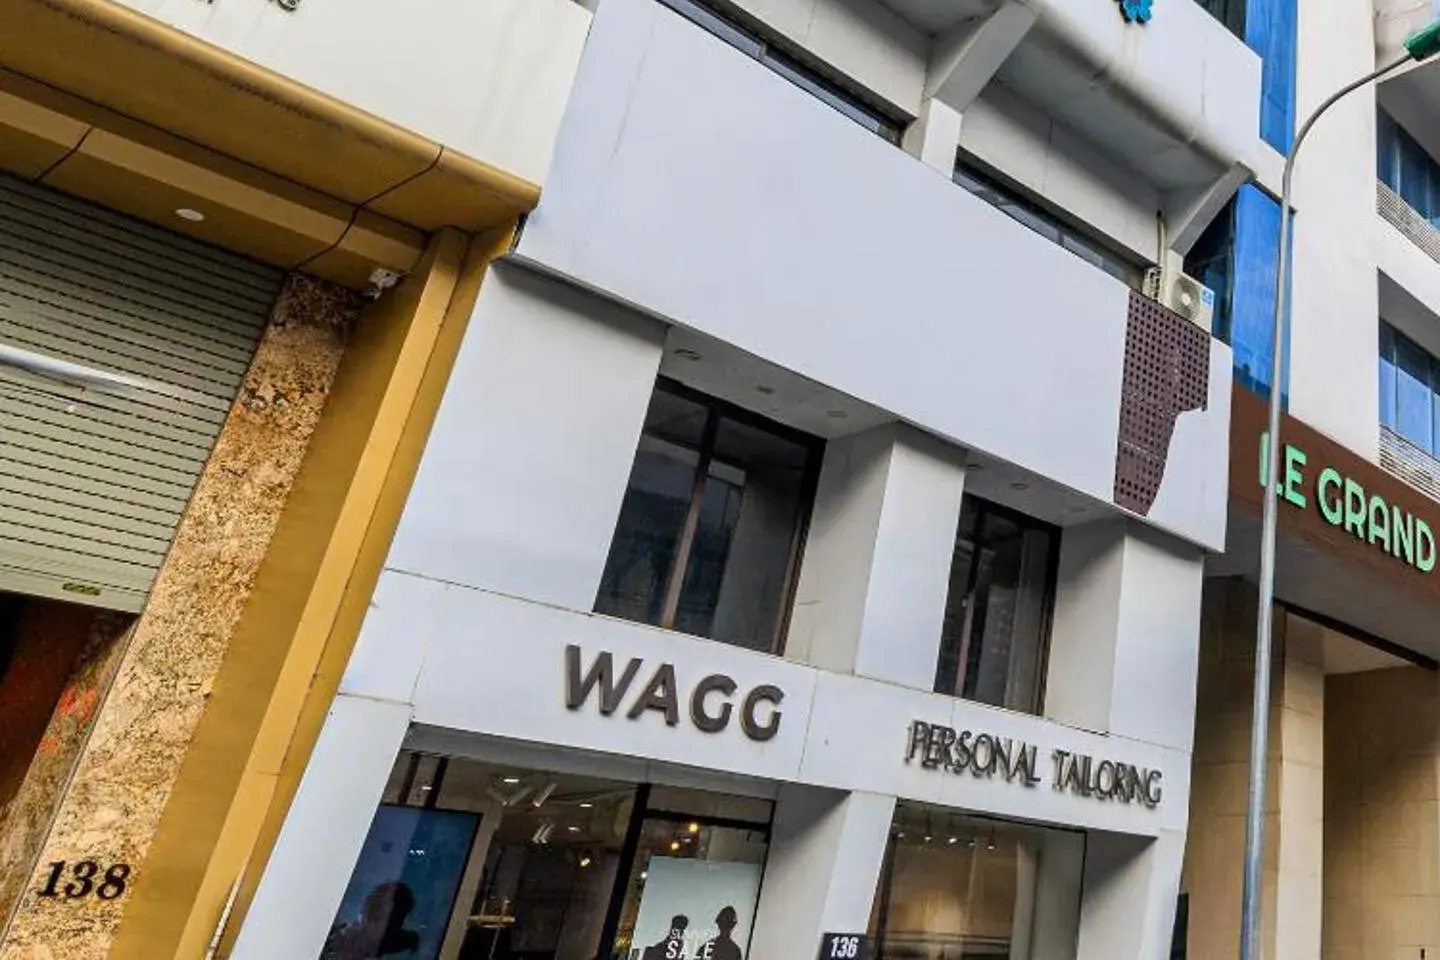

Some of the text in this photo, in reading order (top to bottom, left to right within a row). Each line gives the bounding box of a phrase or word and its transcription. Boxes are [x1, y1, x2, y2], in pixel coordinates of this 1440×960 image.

[1259, 431, 1307, 509] LE
[1318, 467, 1437, 573] GRAND
[565, 643, 784, 742] WAGG
[905, 719, 1041, 788] PERSONAL
[37, 858, 131, 900] 138
[665, 940, 715, 959] SALE
[829, 936, 859, 958] 136
